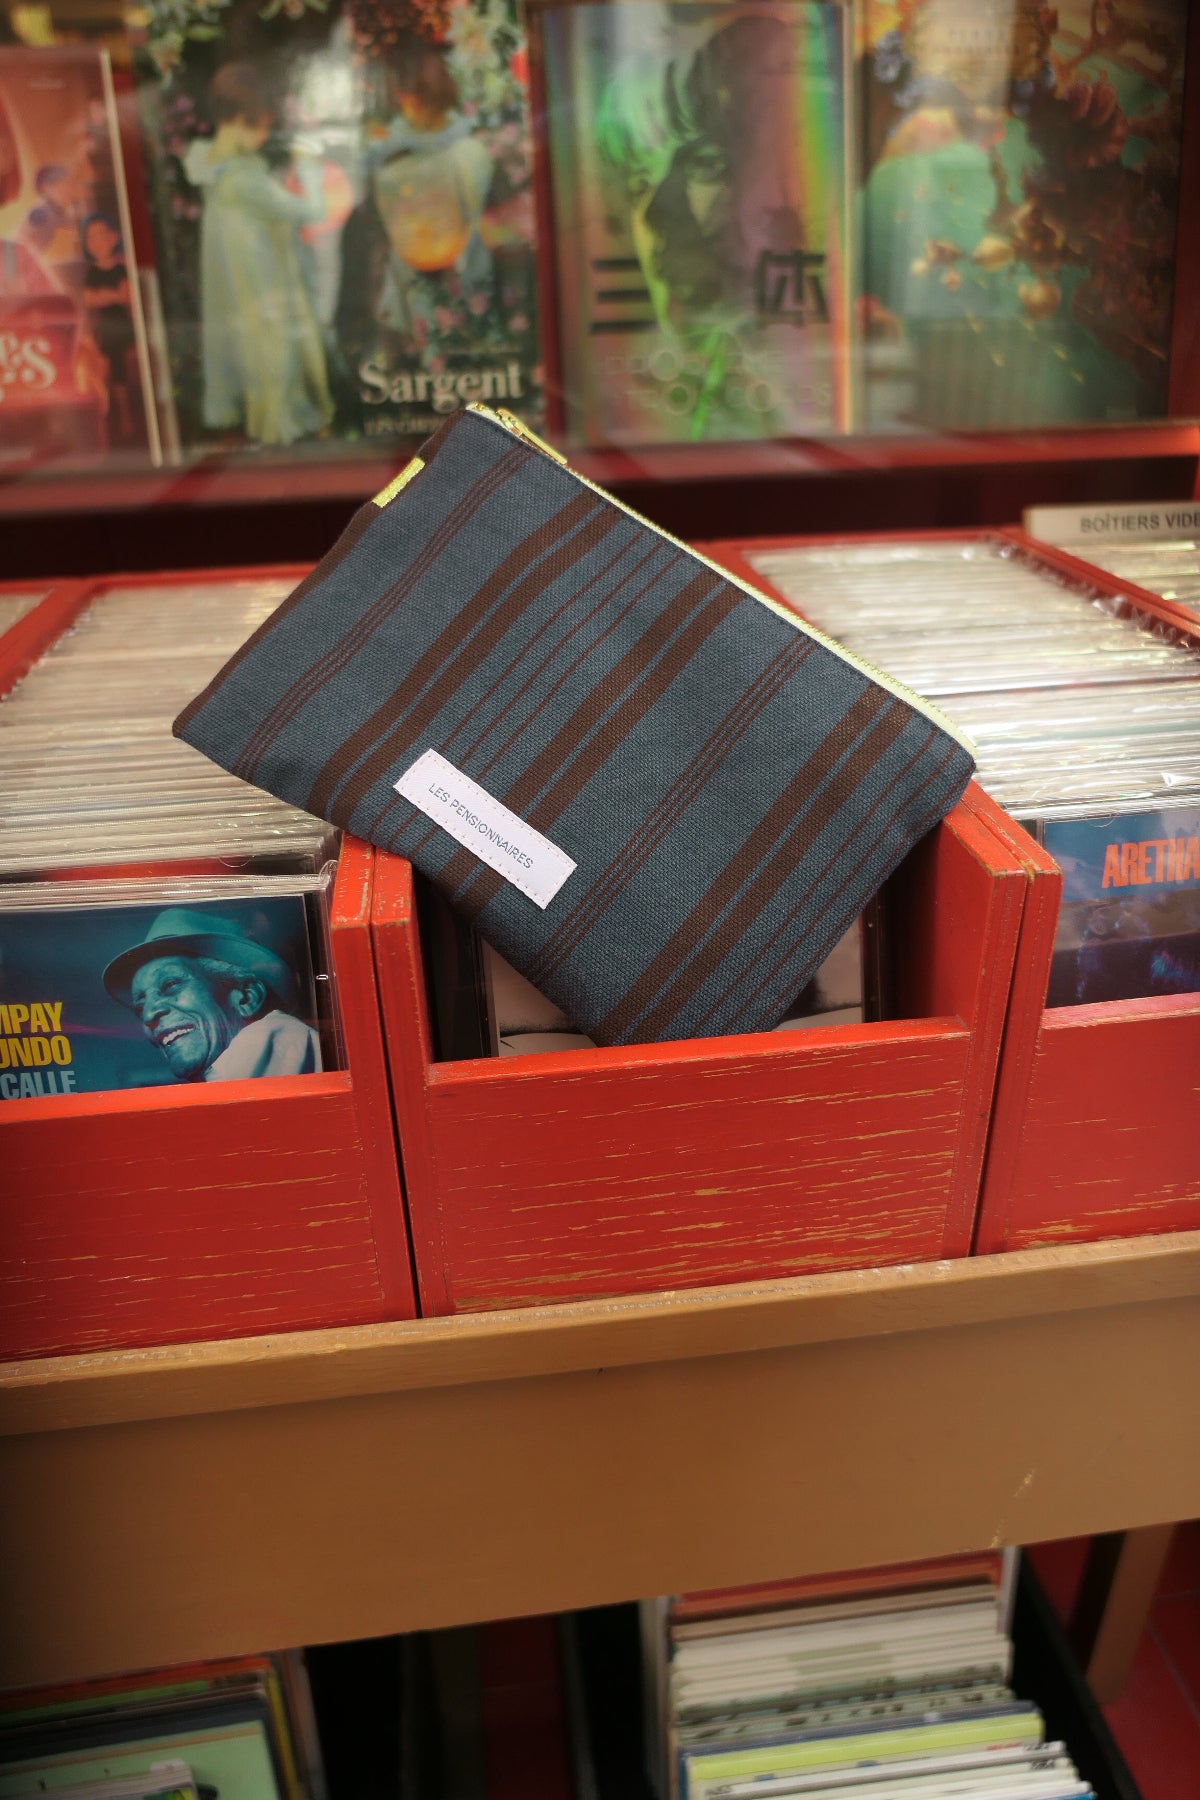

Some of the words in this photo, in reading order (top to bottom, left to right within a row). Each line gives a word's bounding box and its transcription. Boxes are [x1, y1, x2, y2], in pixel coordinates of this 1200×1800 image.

[358, 359, 525, 414] Sargent
[428, 783, 451, 803] LES
[449, 799, 534, 869] PENSIONNAIRES
[1101, 836, 1200, 889] ARETHA
[0, 1070, 78, 1100] CALLE
